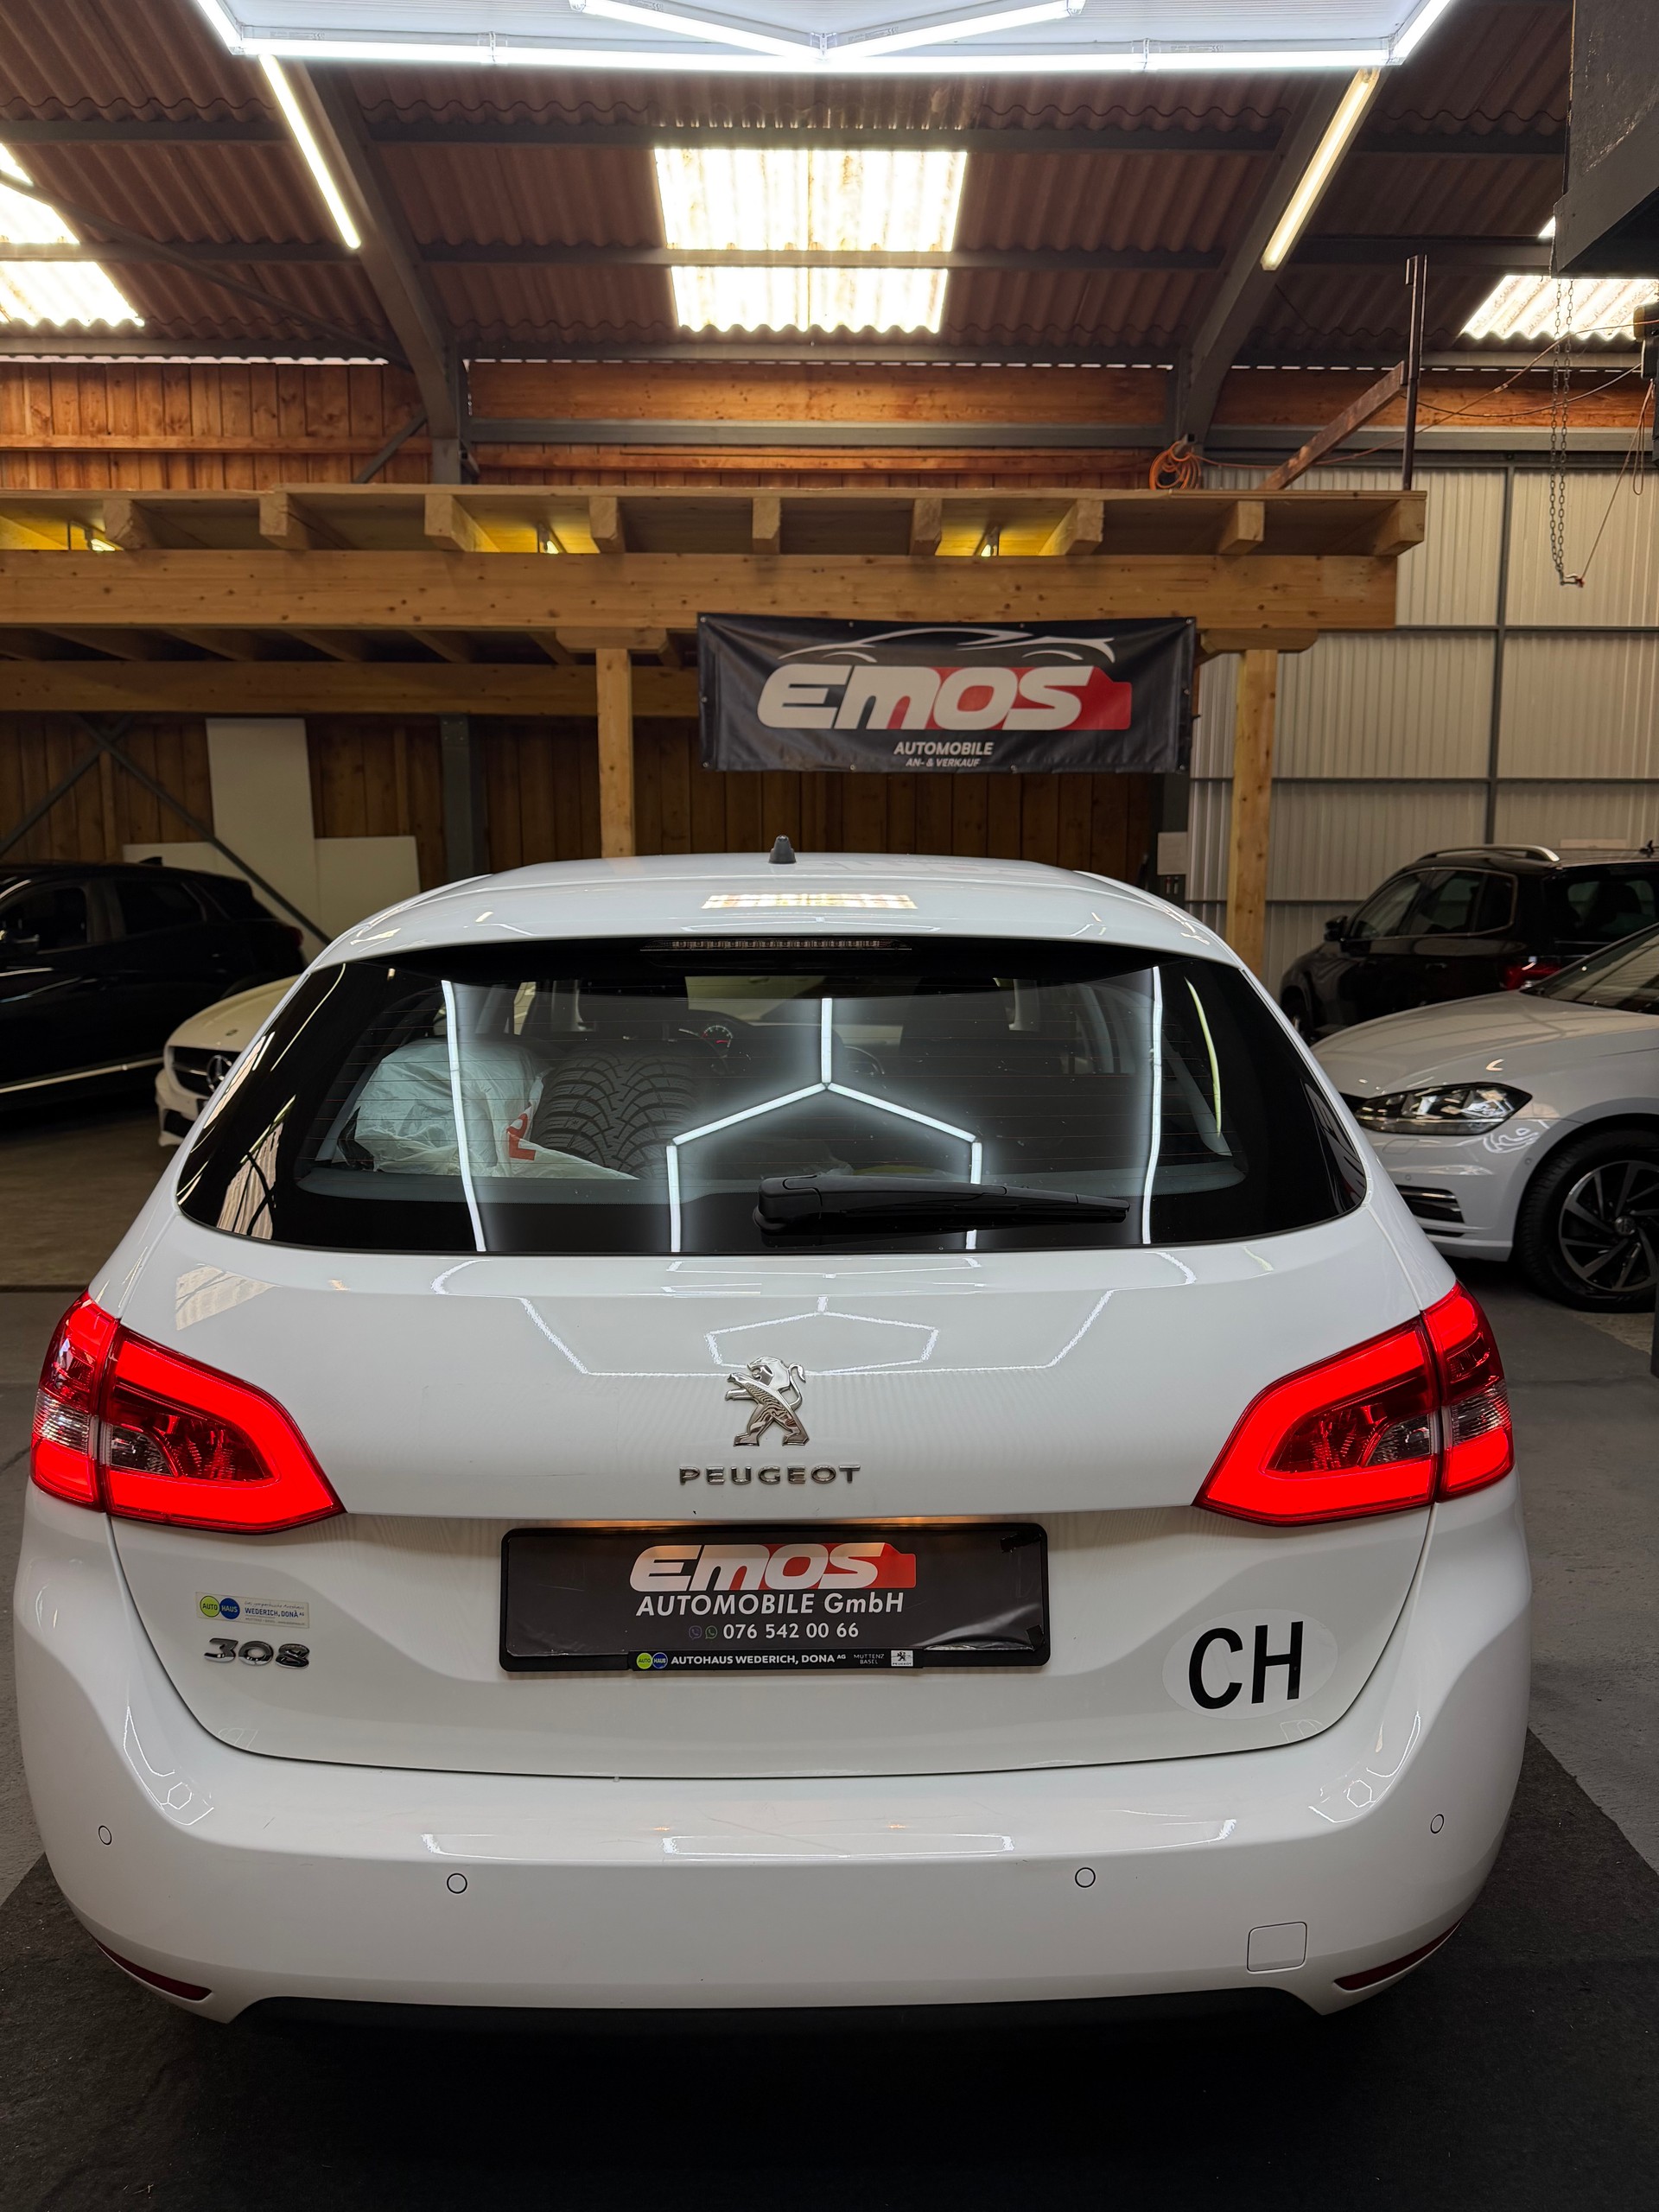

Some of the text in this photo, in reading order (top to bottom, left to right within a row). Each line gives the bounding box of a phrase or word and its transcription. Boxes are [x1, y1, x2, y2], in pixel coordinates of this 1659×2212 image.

[893, 741, 994, 755] AUTOMOBILE
[906, 758, 981, 767] AN- & VERKAUF
[679, 1464, 861, 1486] PEUGEOT
[221, 1605, 238, 1613] HAUS
[635, 1592, 904, 1617] AUTOMOBILE GmbH
[722, 1623, 859, 1640] 076 542 00 66
[203, 1637, 310, 1669] 308
[671, 1656, 734, 1664] AUTOHAUS
[735, 1655, 798, 1665] WEDERICH,
[801, 1655, 836, 1663] DONA
[1188, 1620, 1304, 1710] CH
